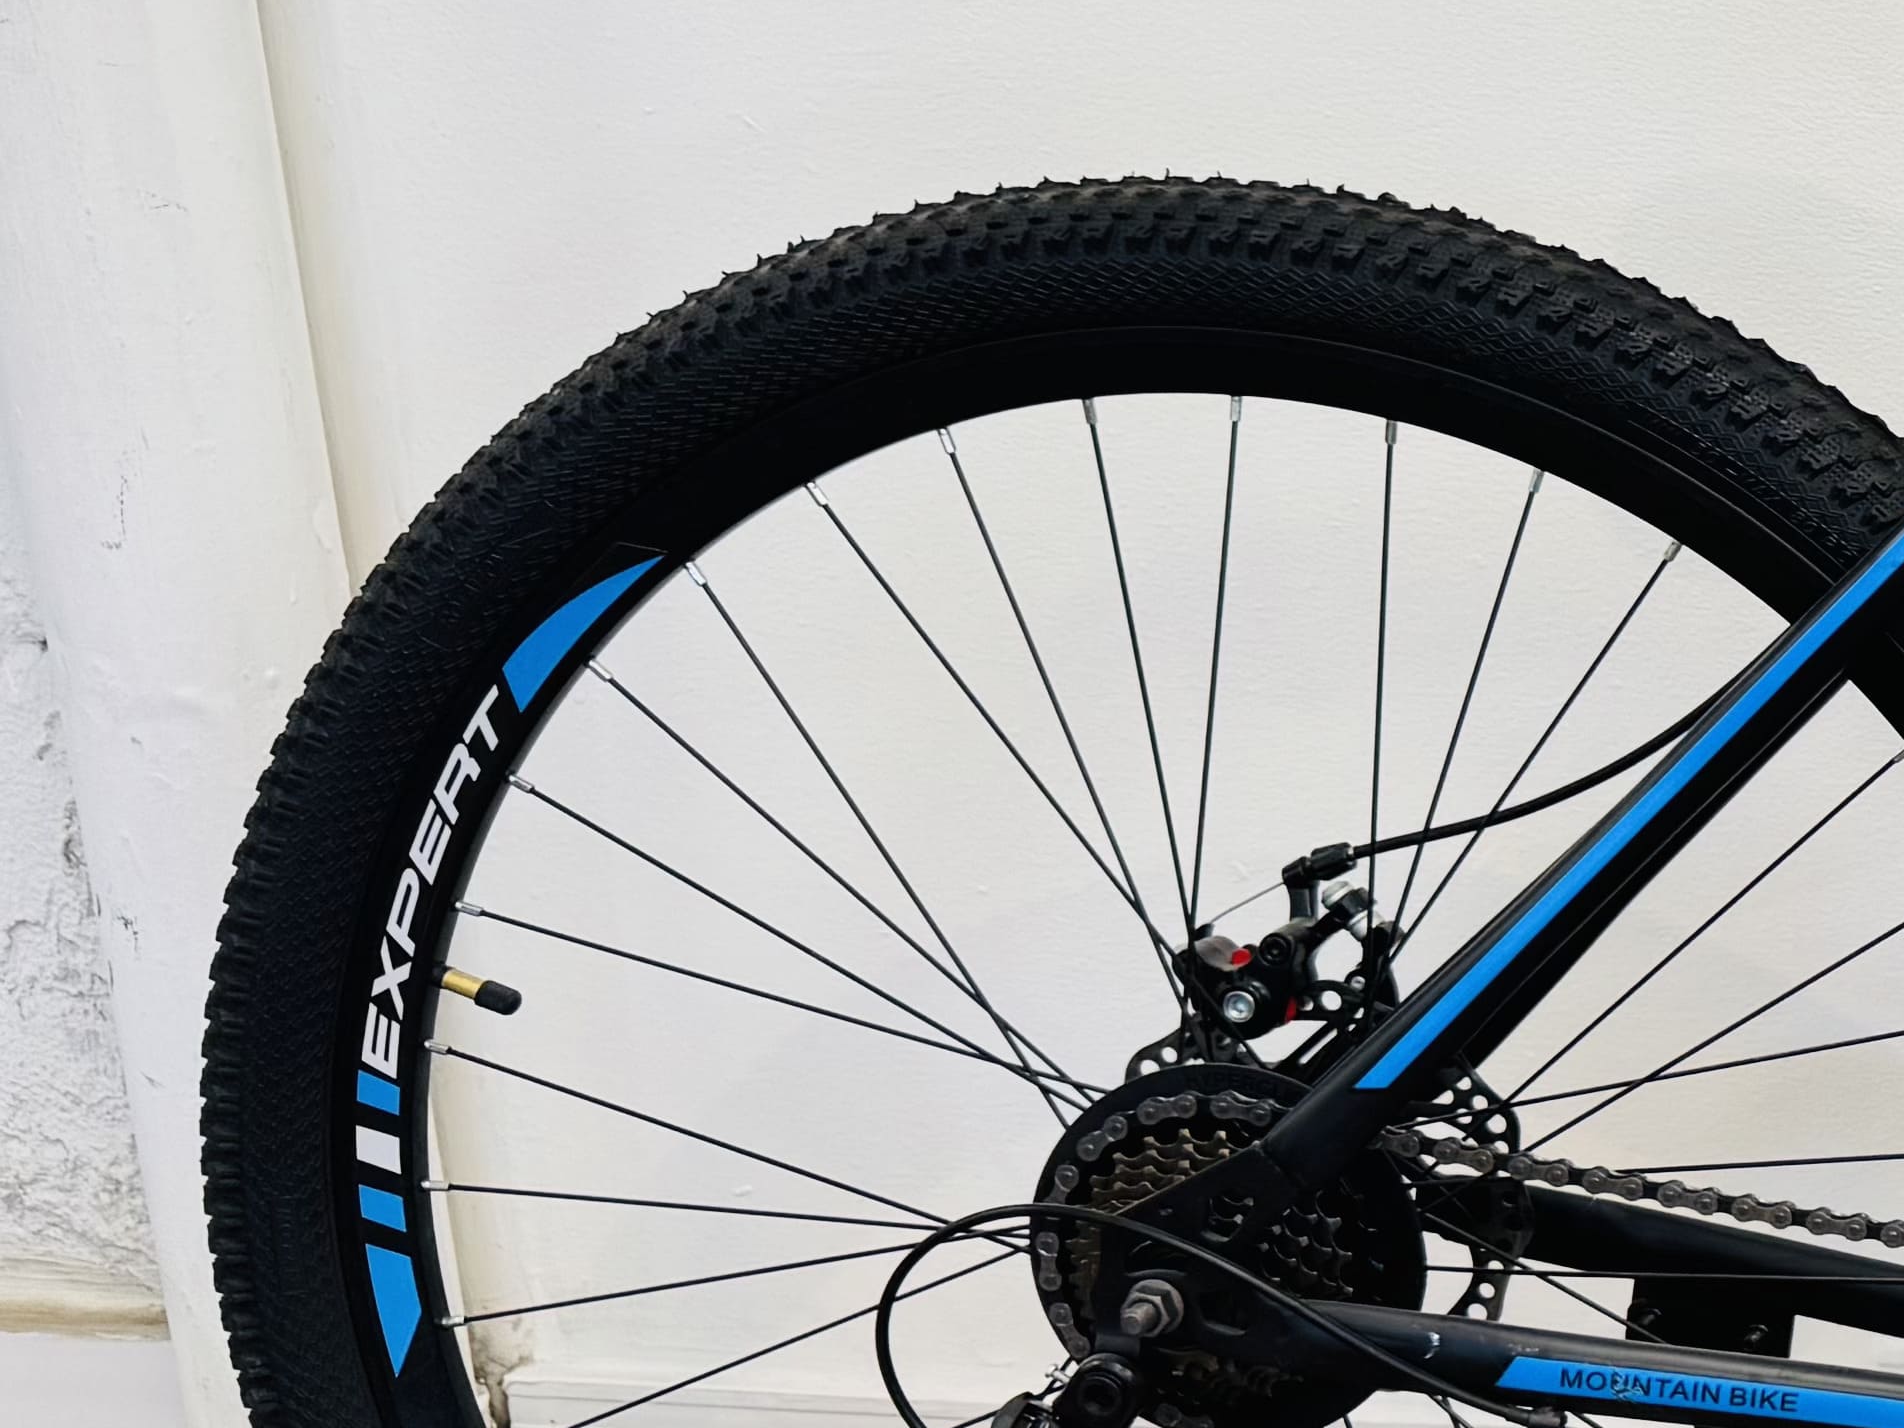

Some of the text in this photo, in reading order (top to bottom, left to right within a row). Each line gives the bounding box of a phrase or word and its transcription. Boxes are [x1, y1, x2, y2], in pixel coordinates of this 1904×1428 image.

[360, 684, 502, 1079] EXPERT
[1559, 1368, 1800, 1413] MOUNTAIN BIKE
